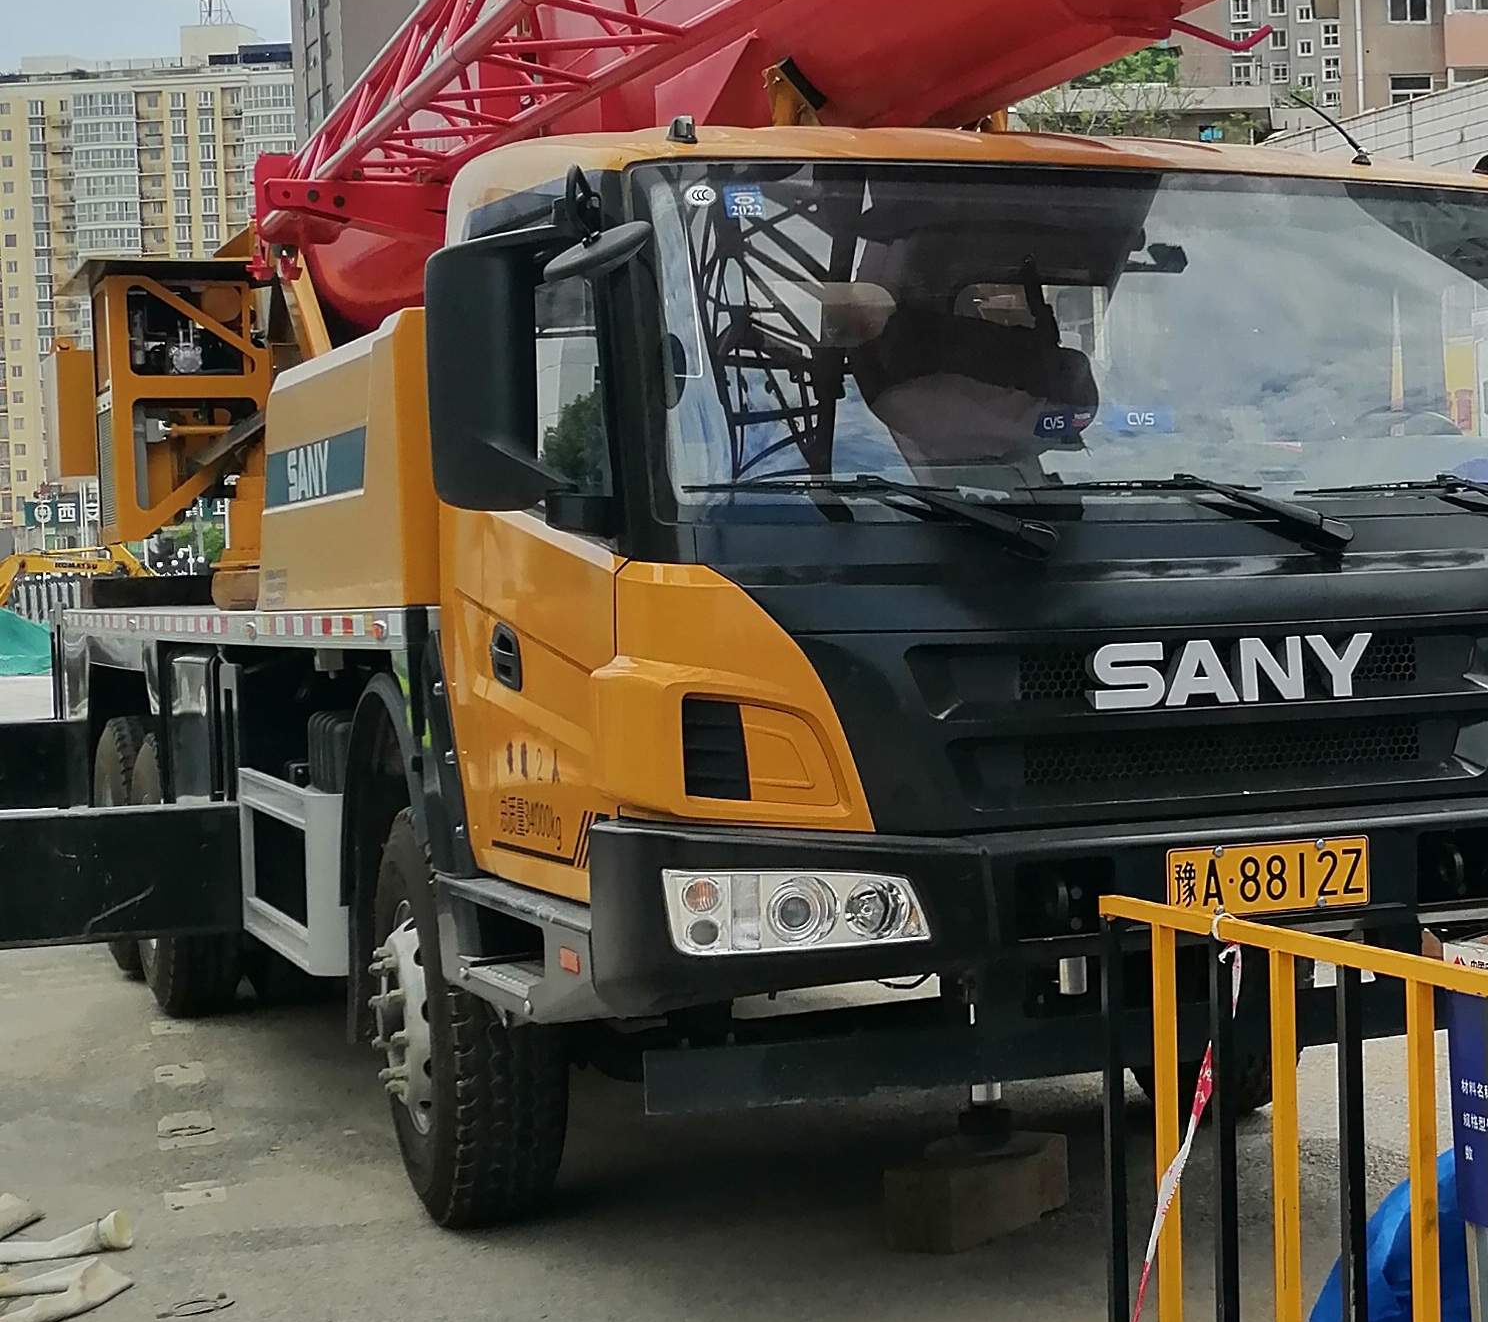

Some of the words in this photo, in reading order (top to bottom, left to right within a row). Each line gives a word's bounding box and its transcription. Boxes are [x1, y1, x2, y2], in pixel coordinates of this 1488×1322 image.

[730, 204, 763, 216] 2022
[1043, 415, 1065, 430] CVS
[1126, 412, 1156, 426] CVS
[287, 439, 329, 502] SANY
[1091, 631, 1373, 711] SANY
